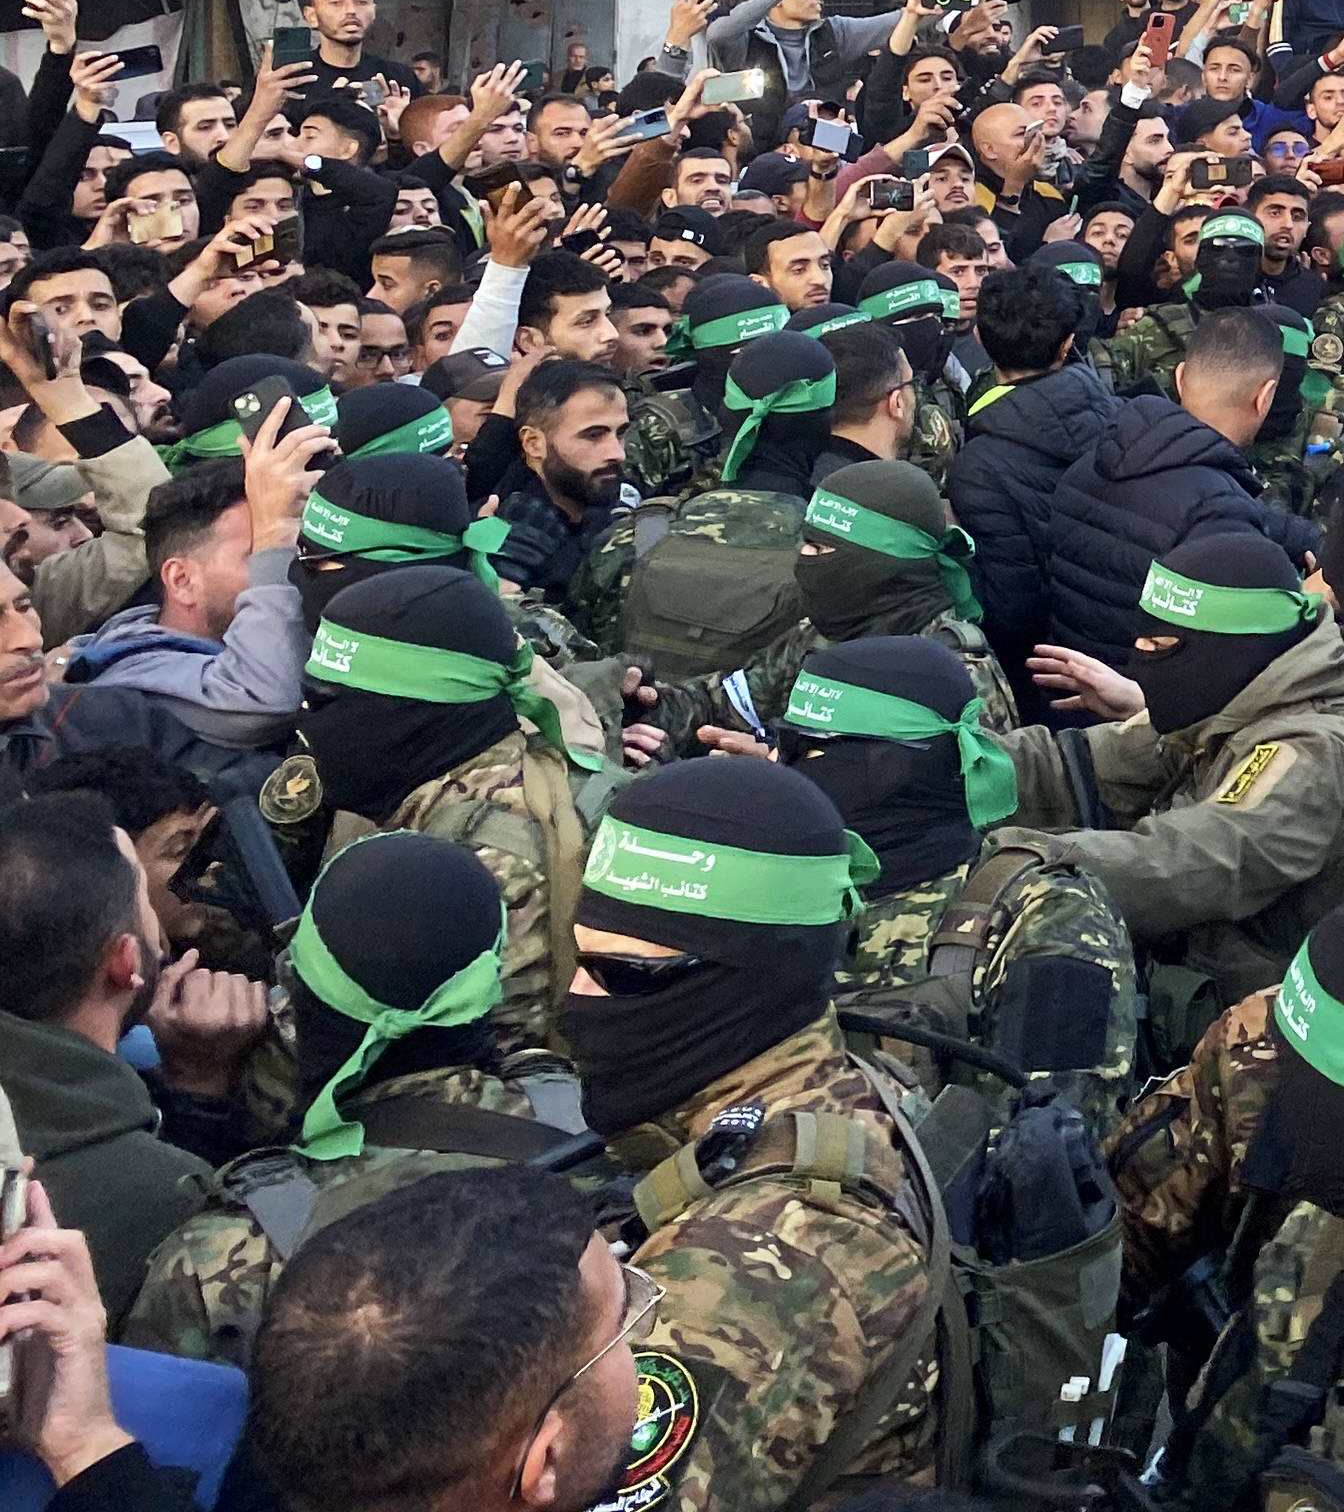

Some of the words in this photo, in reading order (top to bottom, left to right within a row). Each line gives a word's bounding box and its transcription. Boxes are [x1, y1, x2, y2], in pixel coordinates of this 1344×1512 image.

[1151, 591, 1199, 617] كتائب
[605, 870, 661, 892] الشهيد
[660, 879, 709, 901] كتائب
